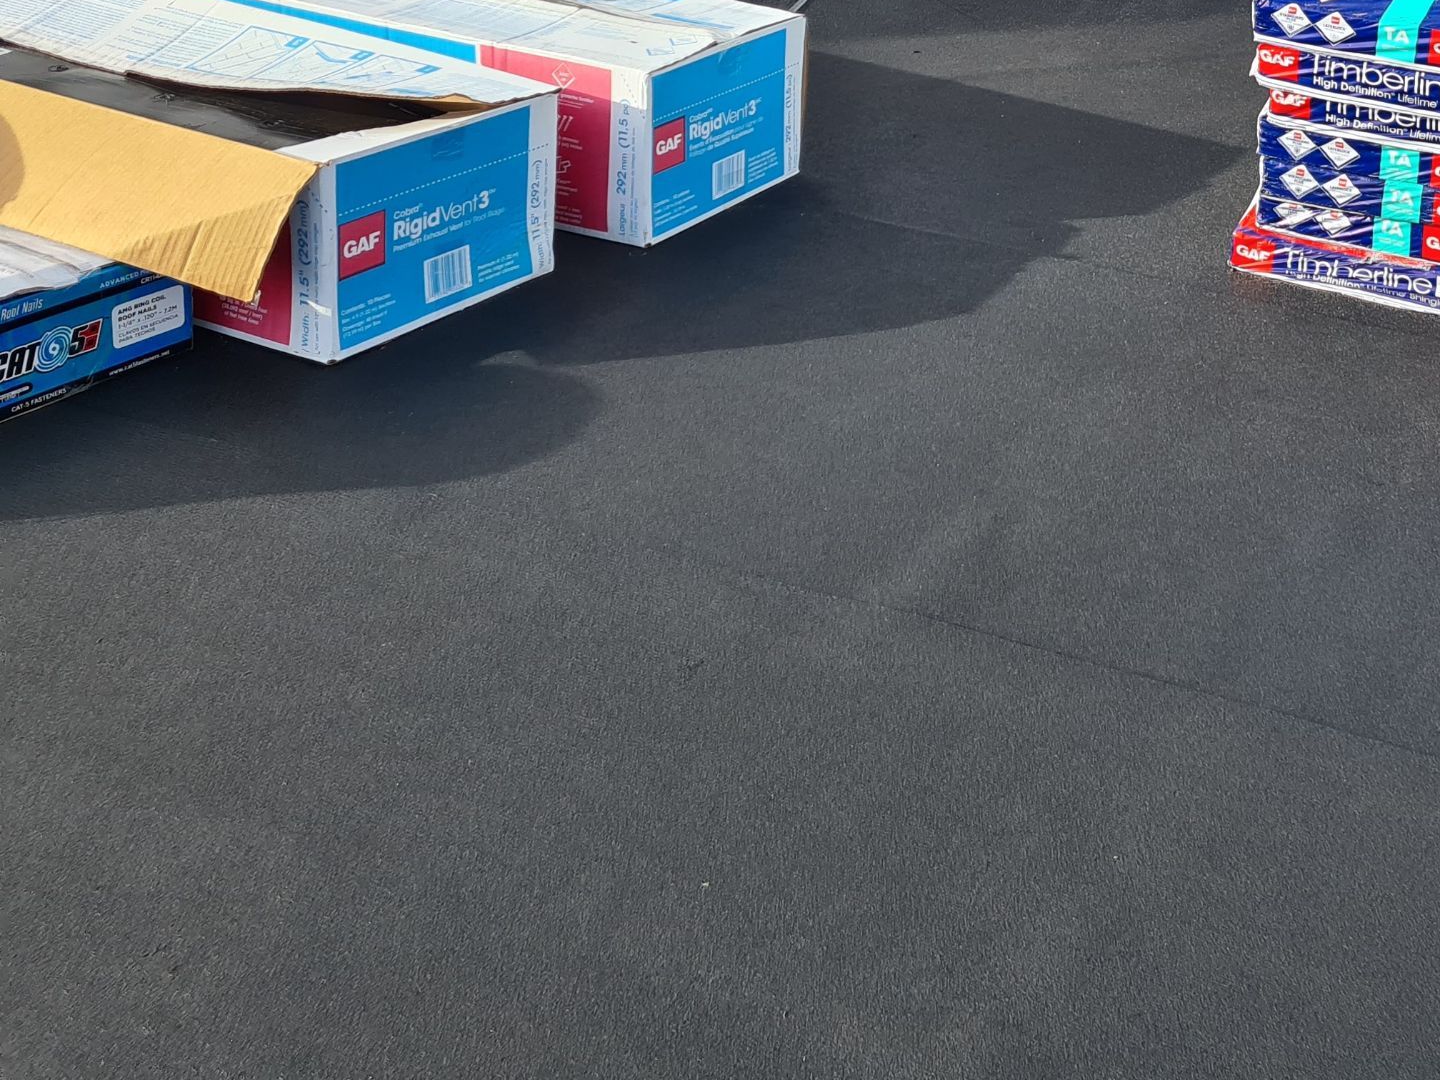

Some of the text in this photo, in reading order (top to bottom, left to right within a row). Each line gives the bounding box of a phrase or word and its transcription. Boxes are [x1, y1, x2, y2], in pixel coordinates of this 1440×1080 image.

[1384, 26, 1411, 44] TA
[1259, 49, 1295, 67] GAF
[1313, 76, 1338, 91] High
[1271, 89, 1308, 107] GAF
[1325, 113, 1351, 128] High
[656, 133, 683, 156] GAF
[1388, 150, 1412, 168] TA
[1391, 190, 1415, 207] TA
[343, 230, 380, 259] GAF
[1236, 244, 1271, 263] GAF
[99, 271, 139, 289] ADVANCED
[1, 297, 43, 321] Roof Nails
[138, 304, 158, 315] NAILS
[301, 311, 310, 347] Width:
[31, 388, 67, 407] FASTENERS
